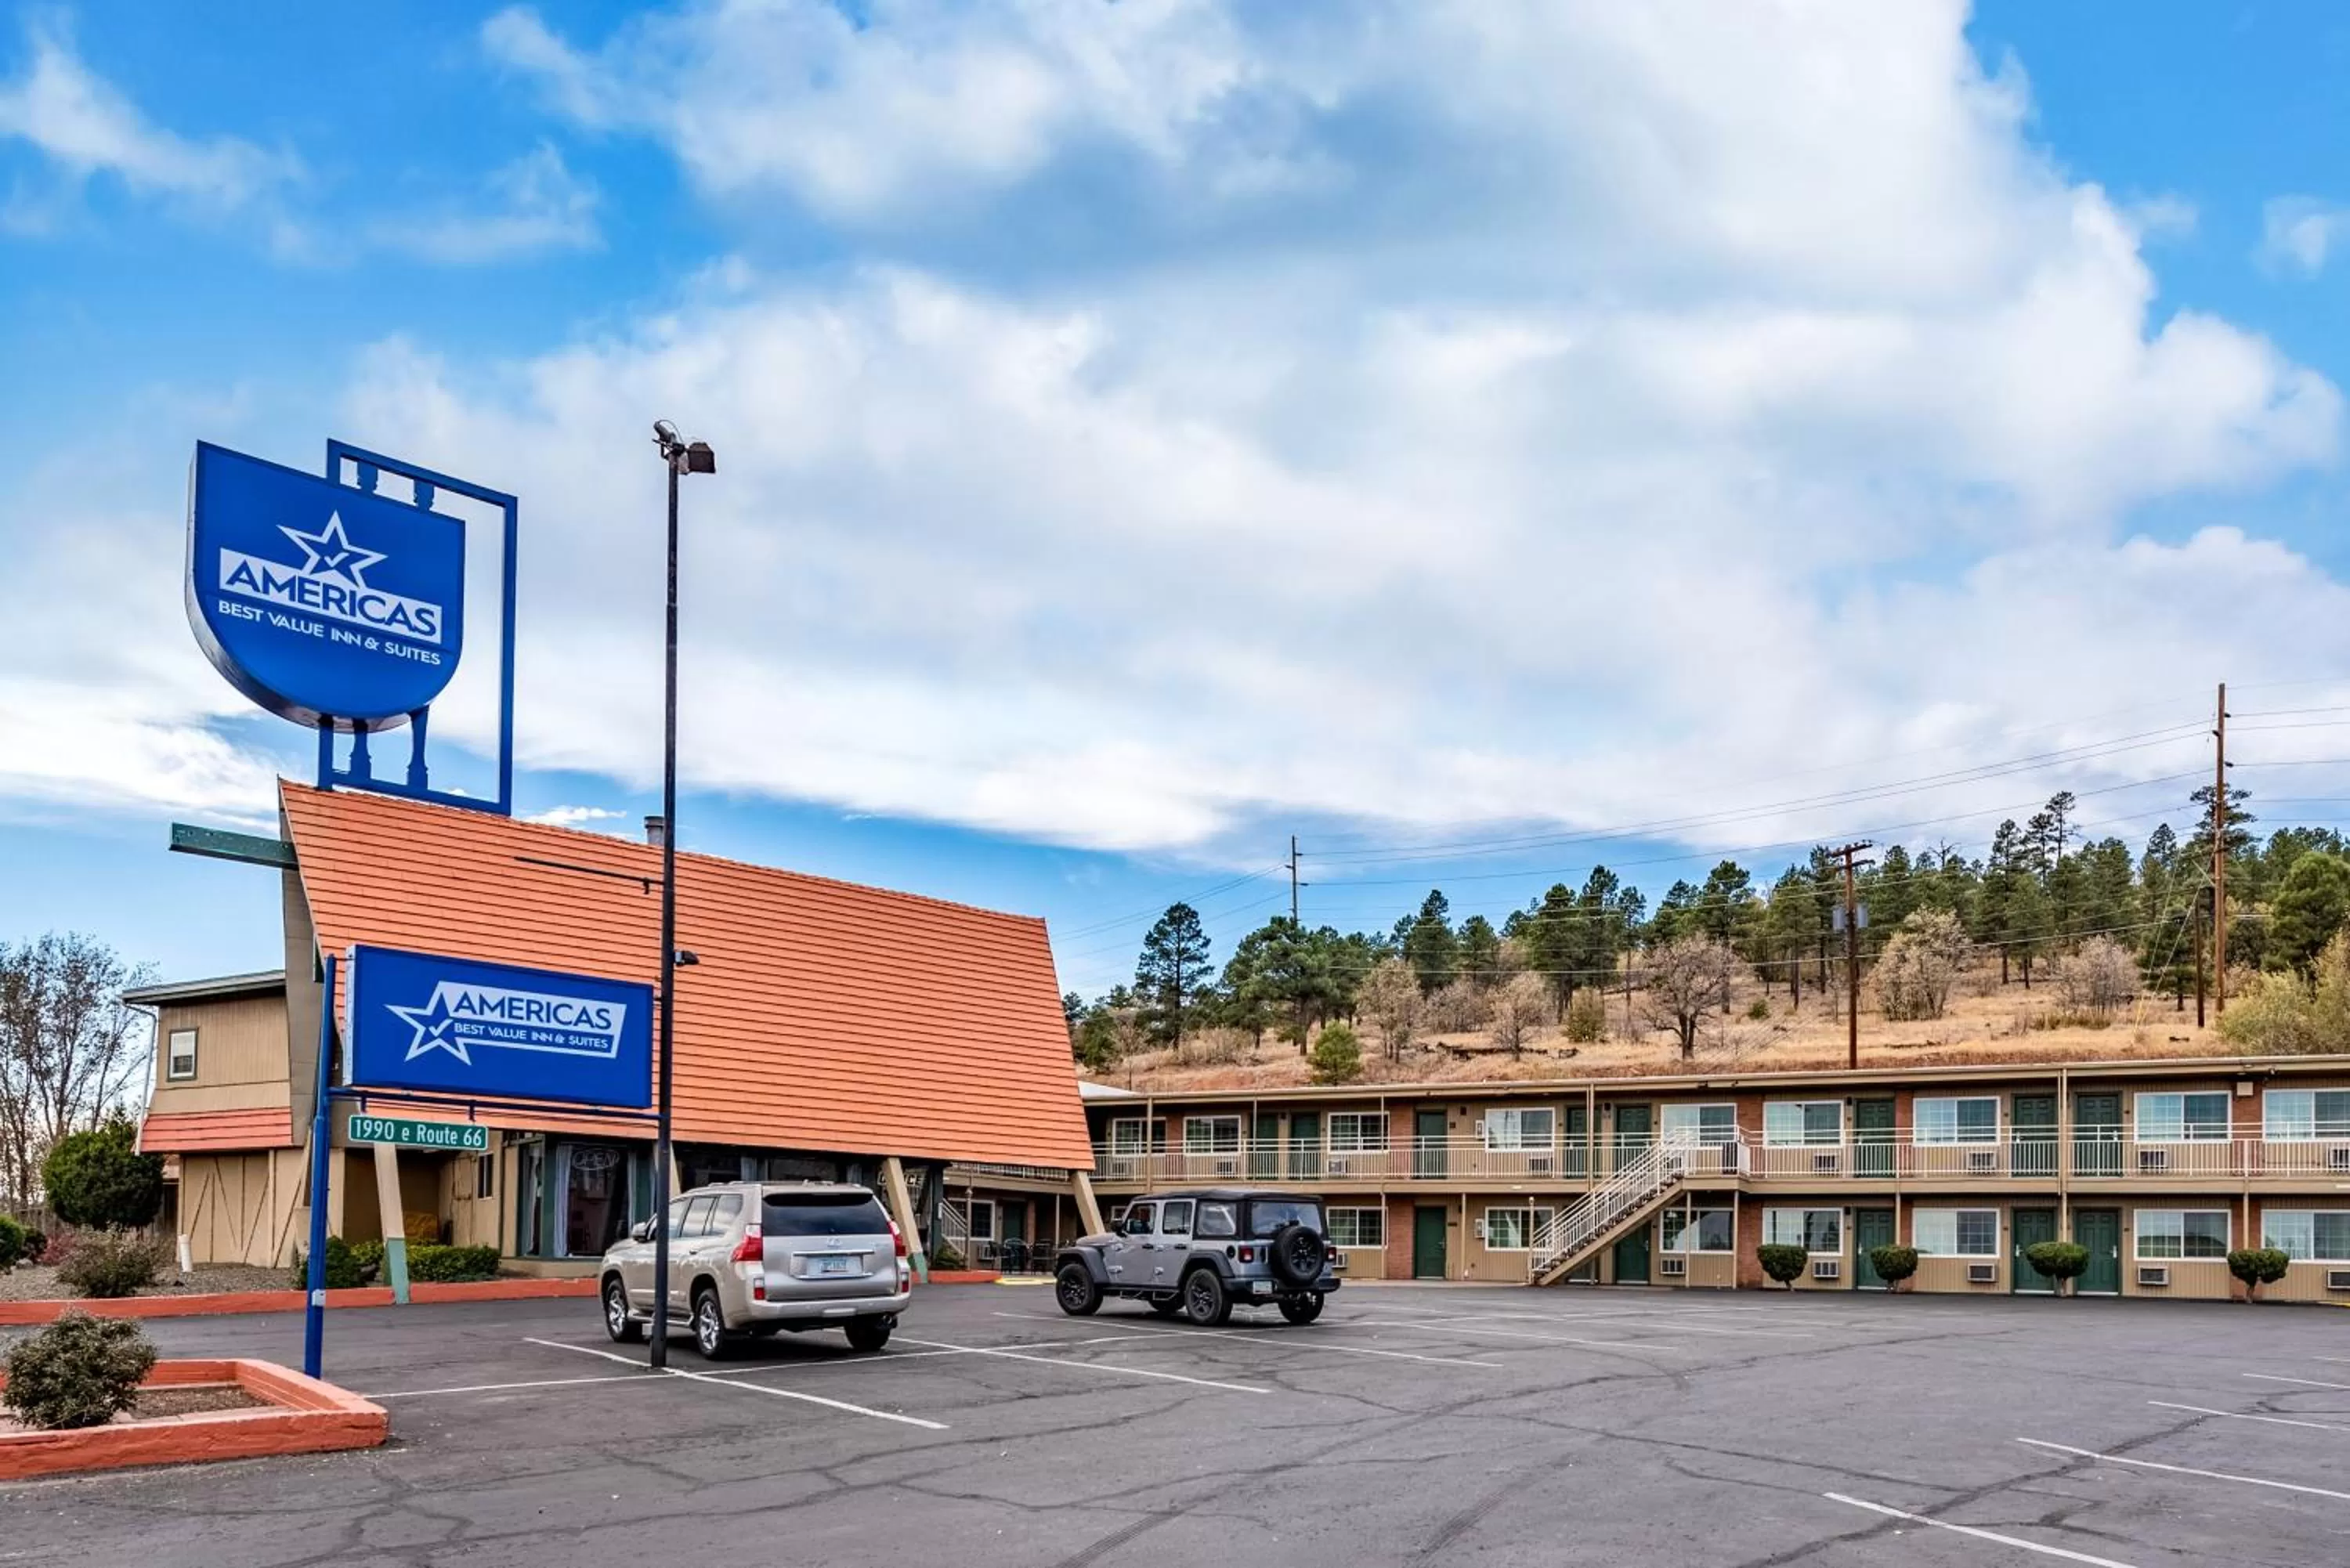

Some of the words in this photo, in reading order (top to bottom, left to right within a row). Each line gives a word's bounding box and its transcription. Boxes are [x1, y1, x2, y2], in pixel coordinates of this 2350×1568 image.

[225, 559, 436, 636] AMERICAS
[219, 600, 264, 622] BEST
[268, 612, 325, 638] VALUE
[331, 627, 361, 647] INN
[363, 637, 380, 651] &
[385, 641, 441, 665] SUITES
[453, 990, 612, 1030] AMERICAS
[454, 1022, 485, 1035] BEST
[488, 1026, 527, 1040] VALUE
[530, 1031, 553, 1042] INN
[569, 1035, 609, 1049] SUITES
[355, 1119, 394, 1140] 1990
[401, 1127, 410, 1141] e
[416, 1124, 458, 1145] Route
[463, 1129, 482, 1147] 66
[575, 1150, 616, 1166] OPEN
